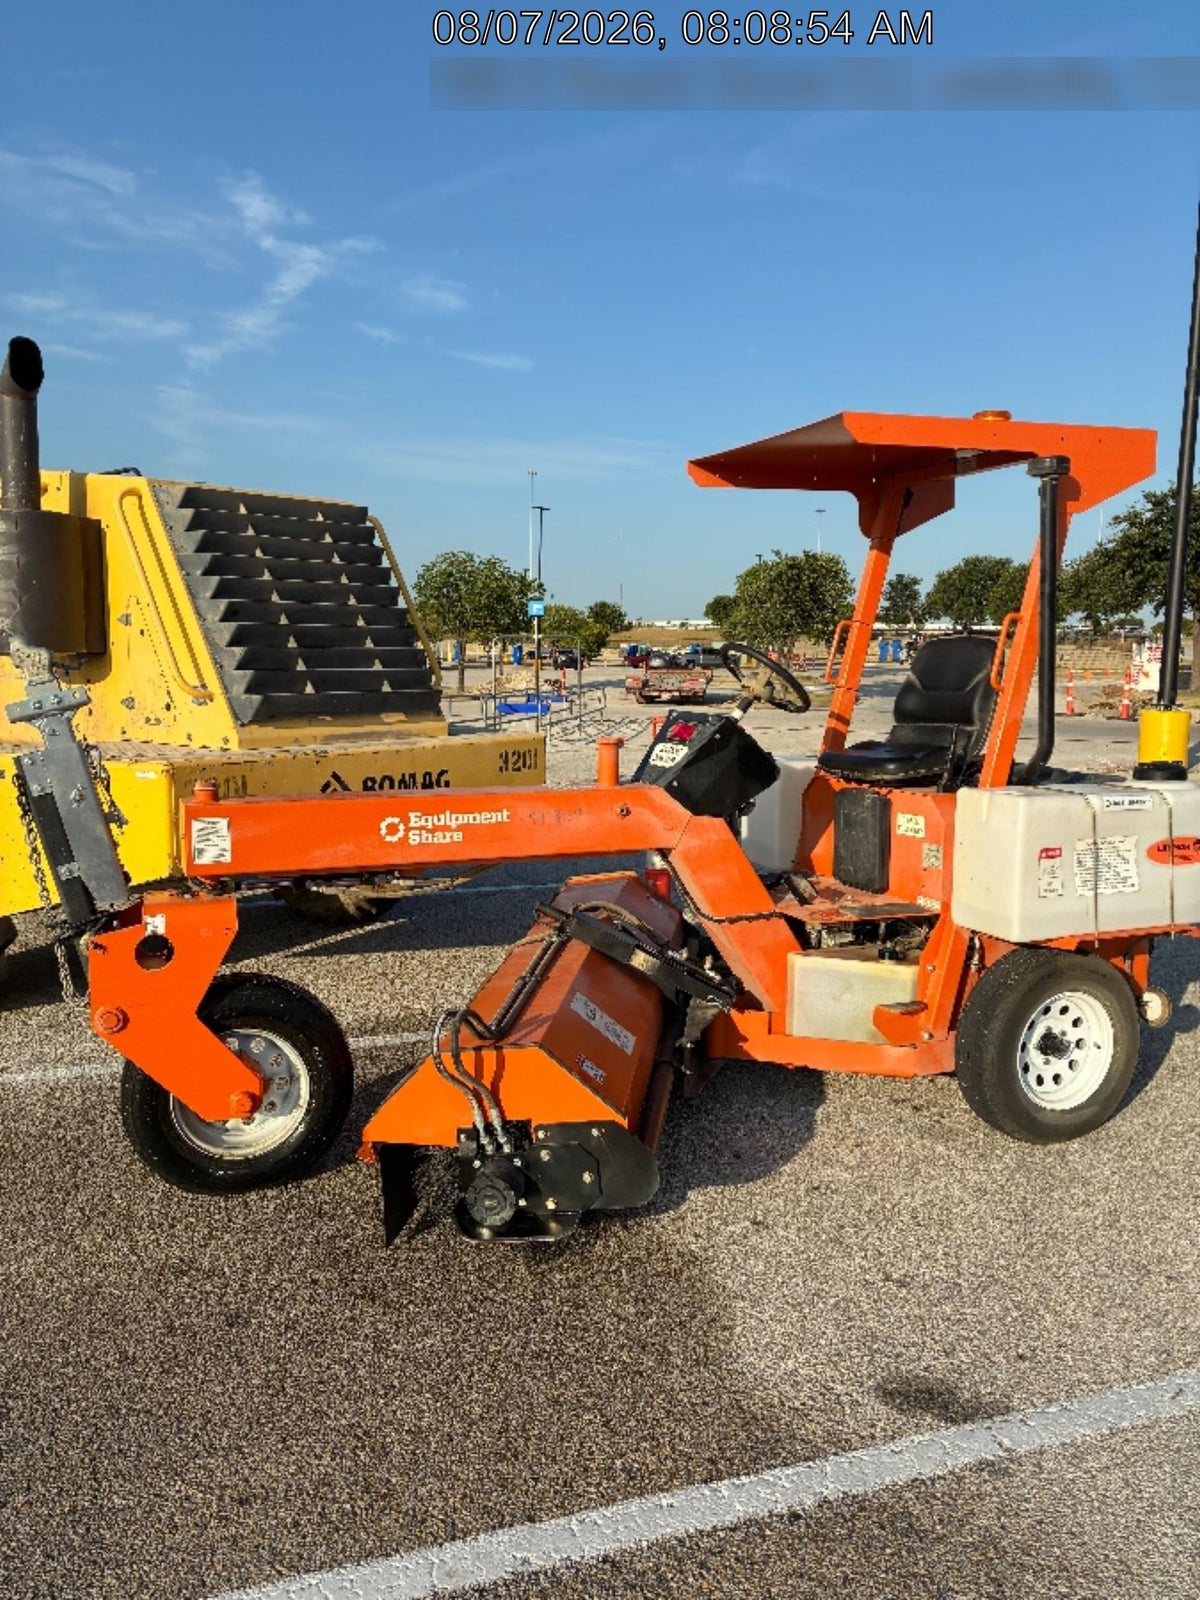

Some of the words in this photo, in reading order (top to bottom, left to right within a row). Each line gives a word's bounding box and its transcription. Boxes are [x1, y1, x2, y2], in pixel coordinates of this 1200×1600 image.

[362, 769, 450, 792] BOMAG
[408, 809, 510, 829] Equipment
[408, 829, 463, 845] Share
